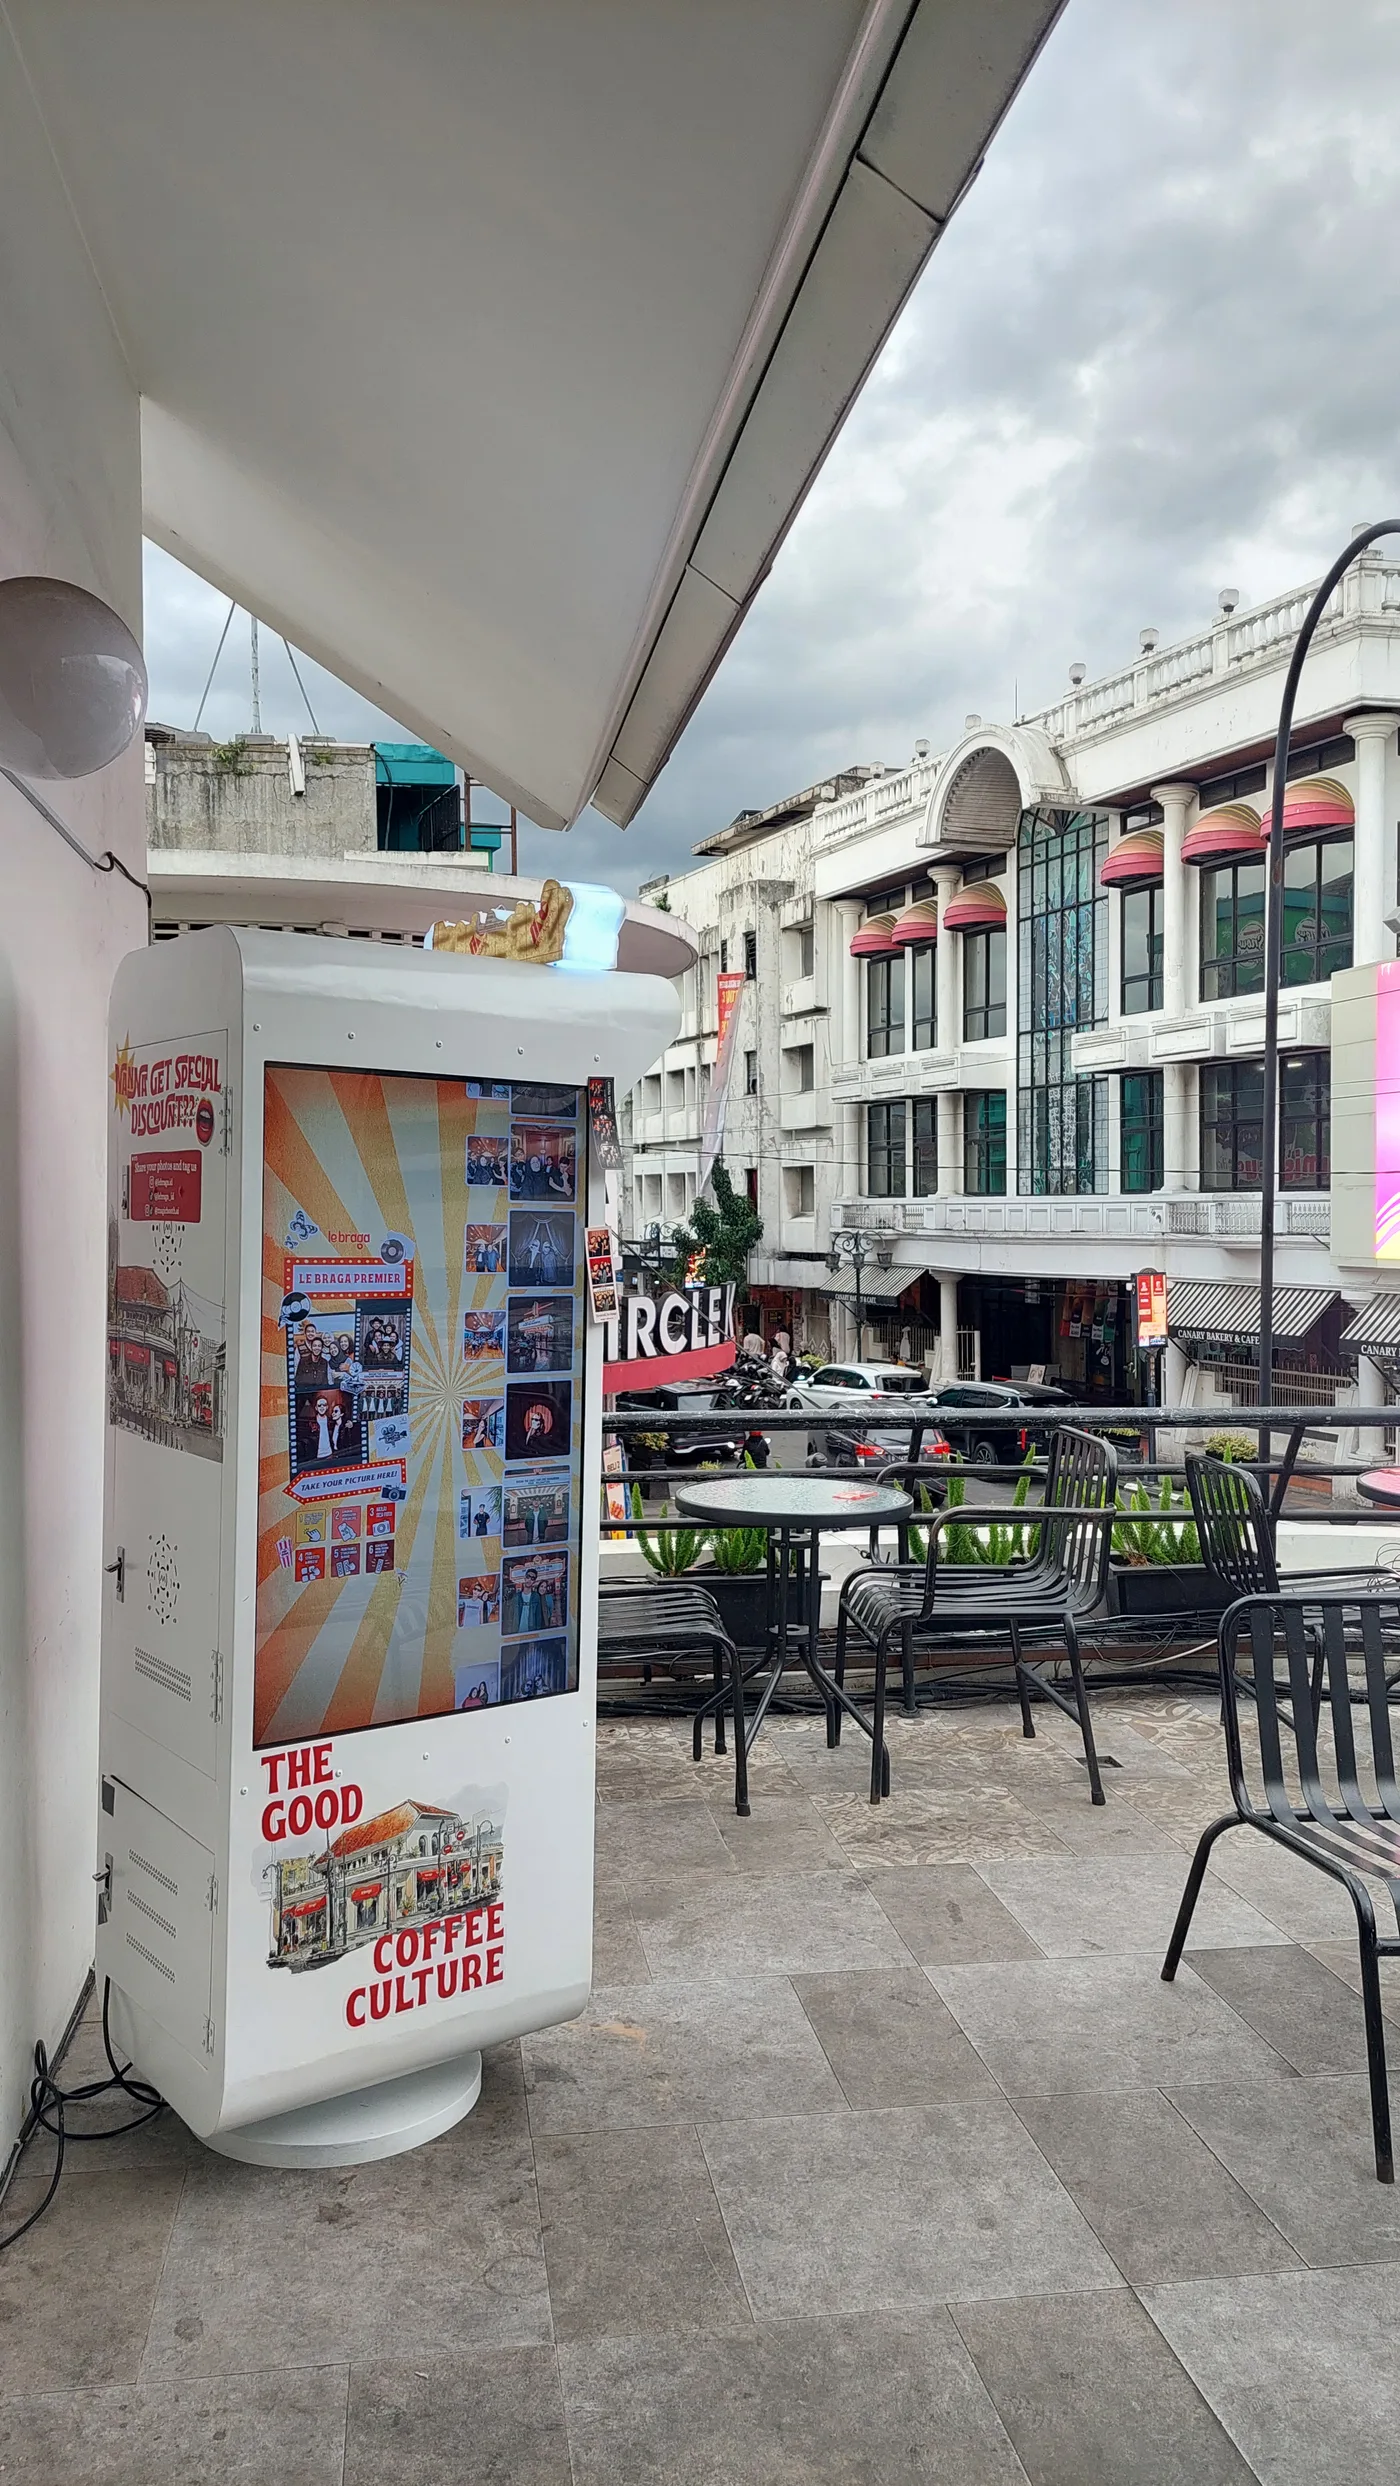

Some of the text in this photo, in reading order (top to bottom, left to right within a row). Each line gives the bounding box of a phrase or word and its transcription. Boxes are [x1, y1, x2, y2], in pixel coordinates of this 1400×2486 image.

[150, 1059, 173, 1096] GET
[174, 1054, 222, 1093] SPECIAL
[299, 1273, 401, 1284] LE BRAGA PREMIER
[1178, 1329, 1260, 1345] CANARY BAKERY & CAFE
[1361, 1344, 1397, 1357] CANARY
[301, 1470, 398, 1492] TAKE YOUR PICTURE HERE!
[334, 1510, 340, 1520] 2
[369, 1507, 375, 1517] 3
[333, 1548, 339, 1558] 5
[368, 1544, 374, 1554] 6
[298, 1552, 304, 1562] 4
[260, 1742, 334, 1794] THE
[261, 1784, 364, 1842] GOOD
[373, 1902, 504, 1974] COFFEE
[345, 1945, 504, 2028] CULTURE
